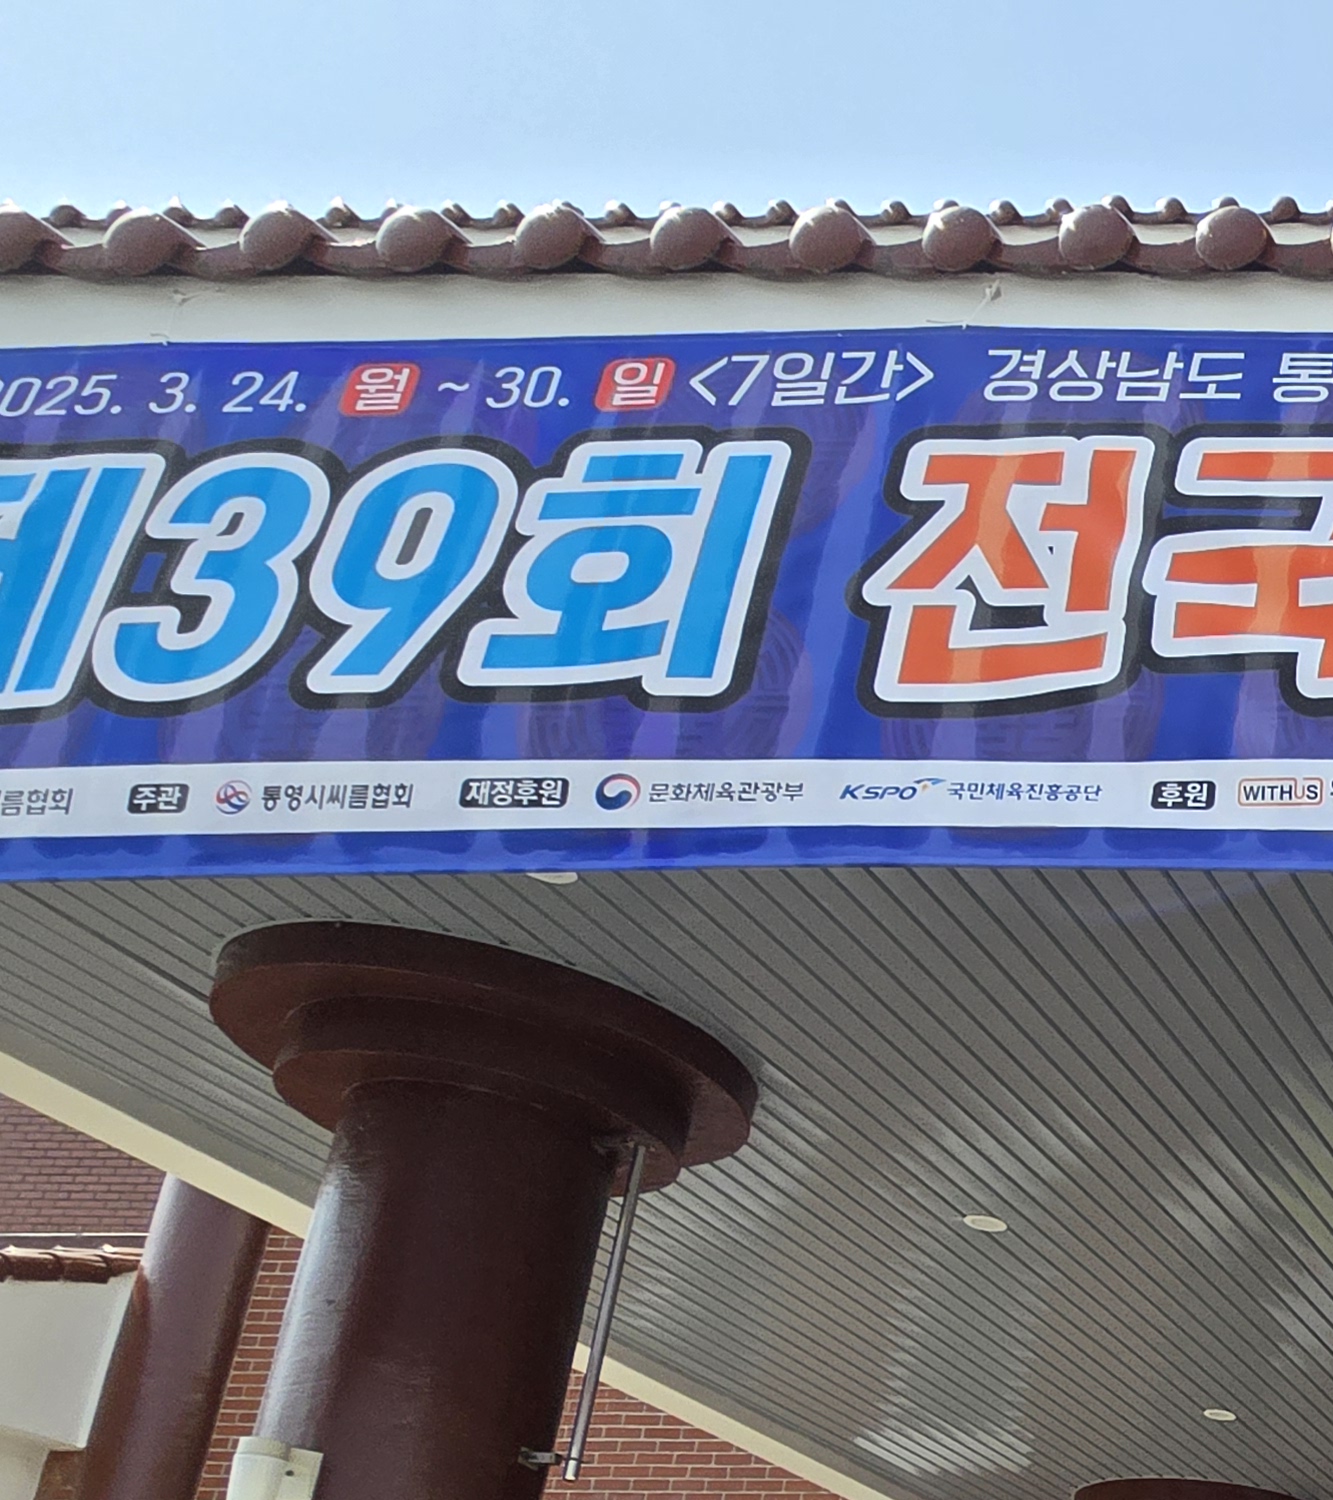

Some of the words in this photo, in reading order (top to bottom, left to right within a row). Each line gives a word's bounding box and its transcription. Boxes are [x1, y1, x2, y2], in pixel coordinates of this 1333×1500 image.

[0, 373, 122, 417] 025.
[148, 372, 196, 414] 3.
[222, 371, 306, 413] 24.
[354, 366, 411, 412] 월
[609, 361, 661, 405] 일
[690, 350, 934, 405] <7일간>
[982, 348, 1246, 403] 경상남도
[0, 438, 792, 708] 제39회
[0, 788, 73, 815] 름협회
[132, 785, 182, 812] 주관
[261, 782, 413, 812] 통영시씨름협회
[465, 780, 563, 806] 재정후원
[648, 781, 804, 803] 문화체육관광부
[839, 783, 917, 801] KSPO
[947, 781, 1103, 803] 국민체육진흥공단
[1157, 783, 1209, 808] 후원
[1243, 784, 1319, 802] WITHUS
